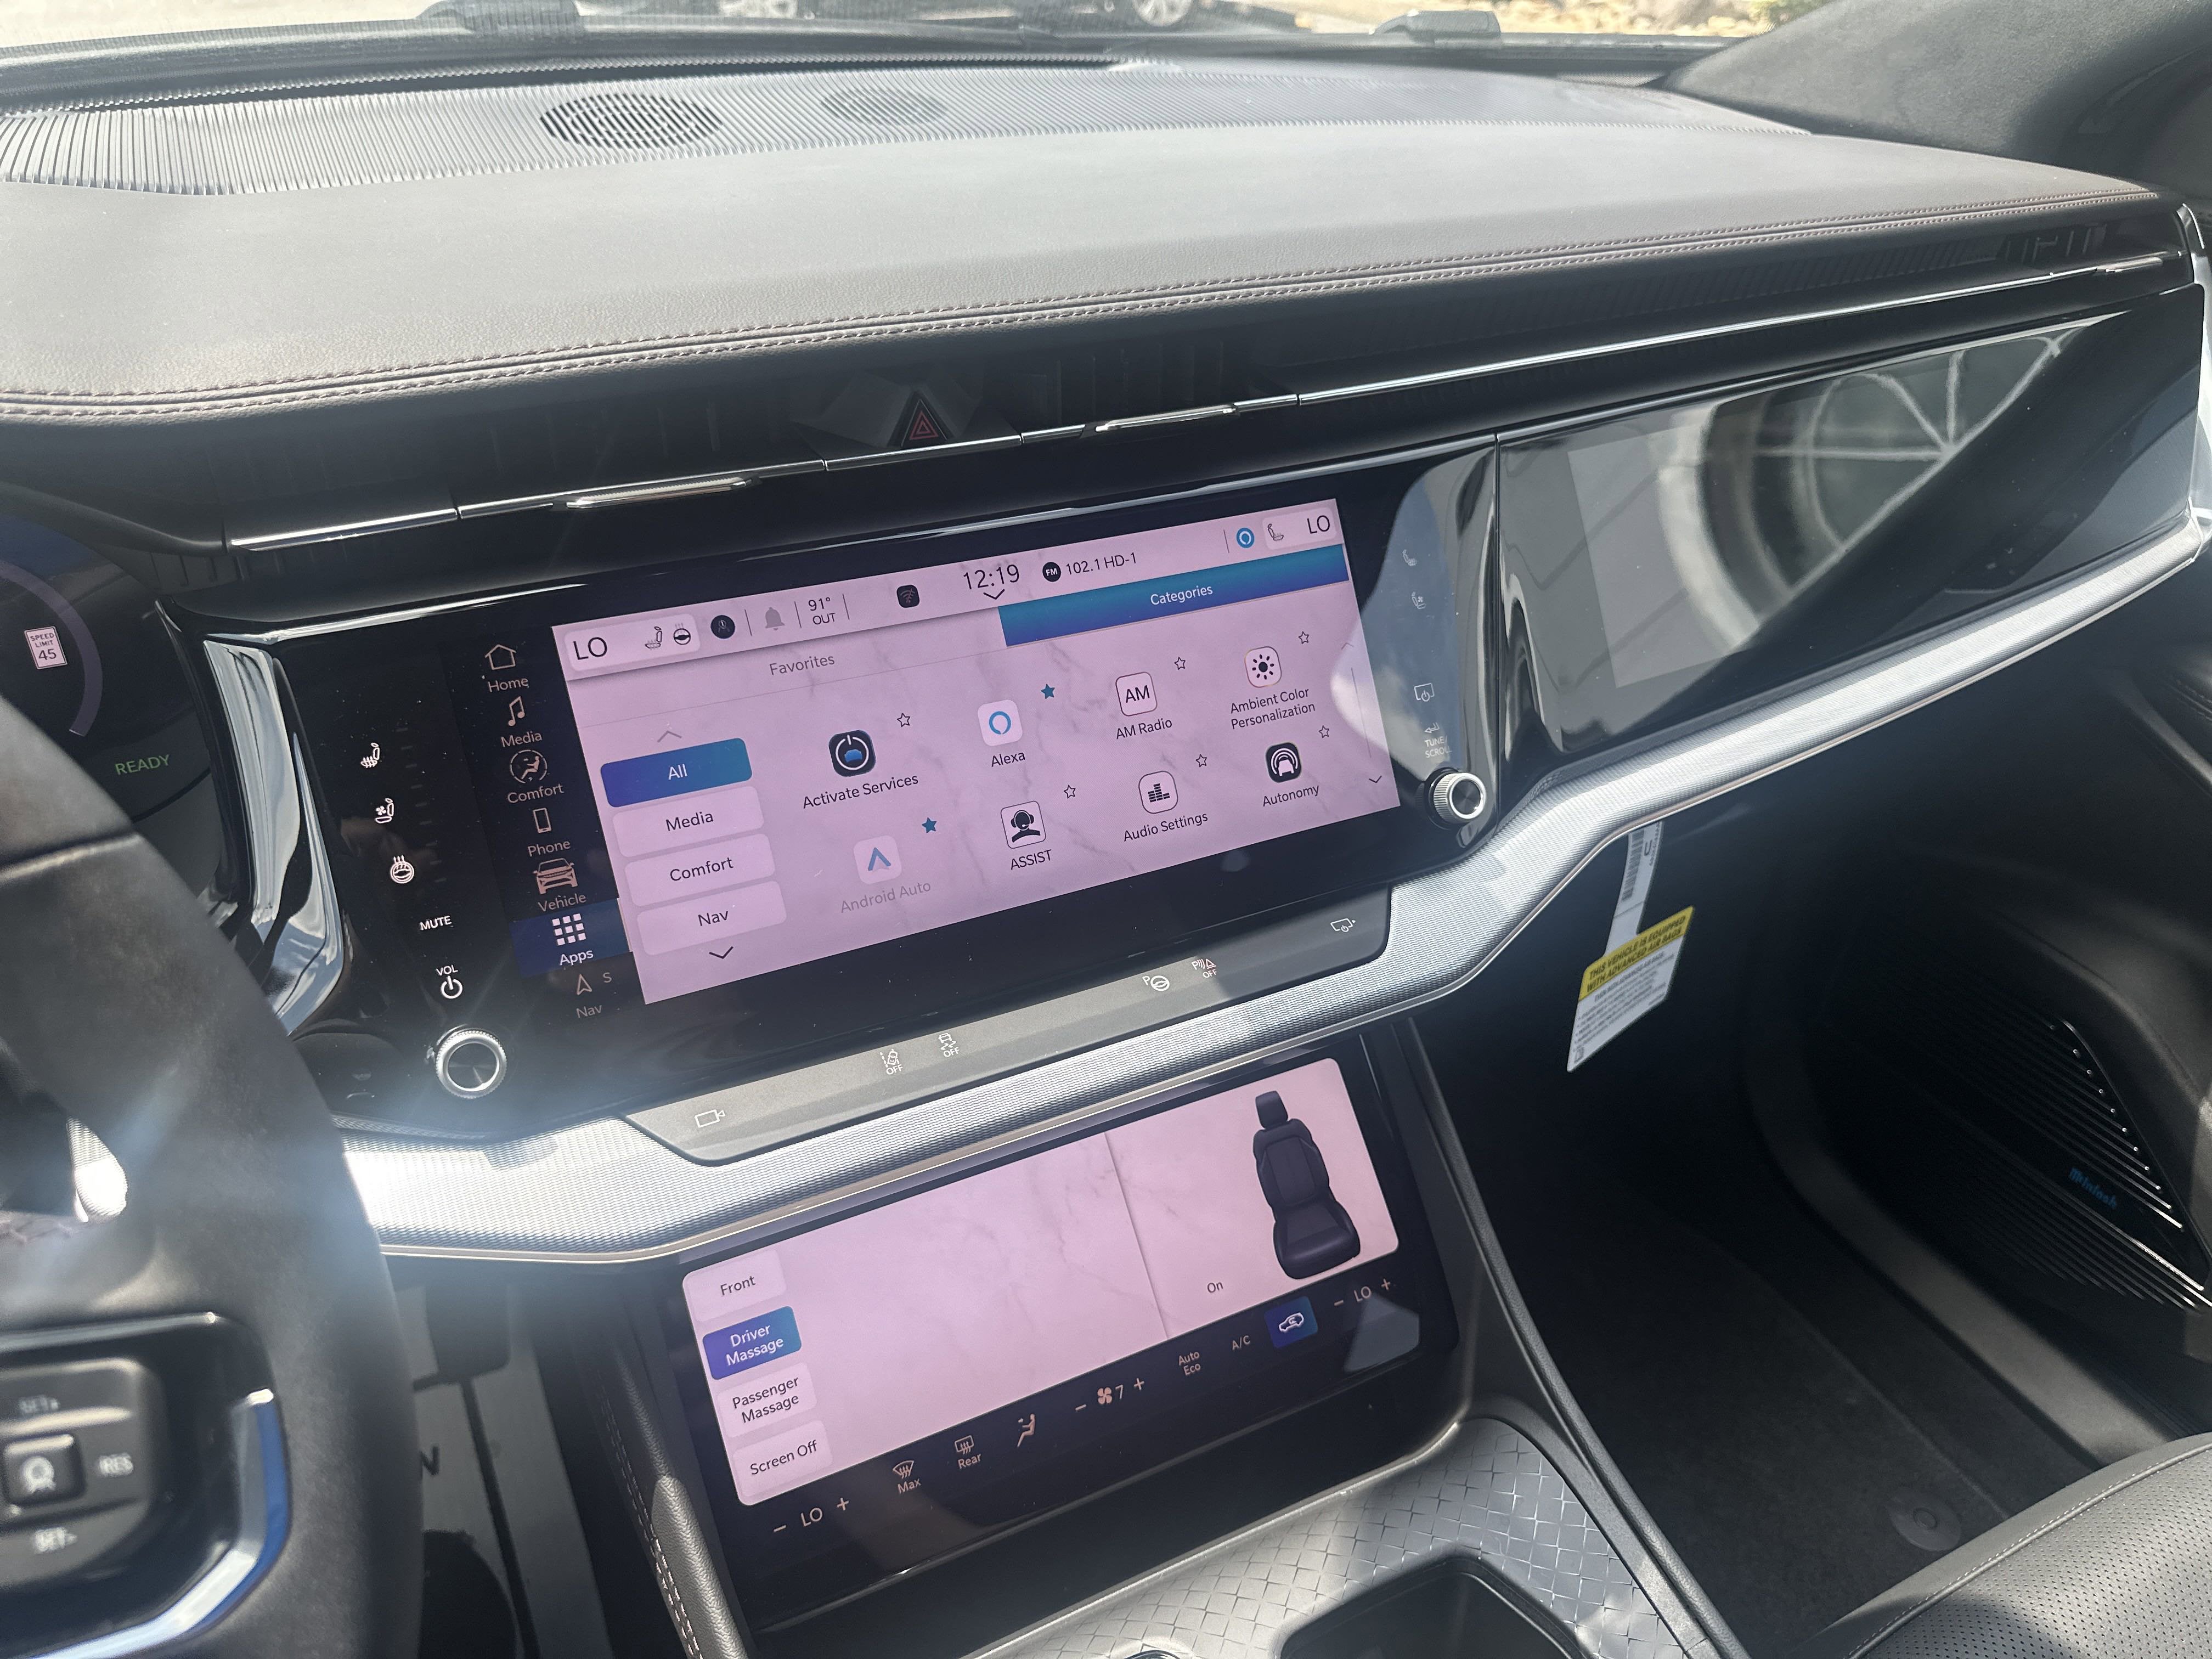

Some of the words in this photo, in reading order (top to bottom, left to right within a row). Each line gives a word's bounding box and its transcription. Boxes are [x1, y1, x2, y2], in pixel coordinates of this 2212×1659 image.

[1307, 515, 1330, 534] LO
[1046, 567, 1058, 576] FM
[1065, 557, 1100, 575] 102.1
[1104, 552, 1137, 569] HD-1
[963, 563, 1020, 590] 12:19
[1150, 584, 1213, 606] Categories
[808, 597, 831, 612] 91°
[812, 612, 836, 626] OUT
[30, 633, 54, 641] SPEED
[38, 648, 57, 661] 45
[573, 636, 608, 660] LO
[769, 654, 834, 675] Favorites
[488, 676, 529, 692] Home
[1125, 686, 1150, 703] AM
[1230, 693, 1278, 714] Ambient
[1280, 687, 1310, 704] Color
[1231, 701, 1315, 729] Personalization
[1116, 725, 1136, 739] AM
[1139, 718, 1172, 735] Radio
[500, 731, 543, 748] Media
[991, 751, 1025, 767] Alexa
[1425, 746, 1453, 758] SCROLL
[115, 754, 170, 775] READY
[668, 765, 687, 780] All
[507, 783, 565, 804] Comfort
[803, 787, 860, 809] Activate
[862, 774, 918, 795] Services
[1263, 785, 1319, 806] Autonomy
[665, 811, 714, 831] Media
[1124, 825, 1158, 843] Audio
[1161, 812, 1208, 832] Settings
[527, 839, 571, 856] Phone
[1011, 849, 1052, 870] ASSIST
[670, 856, 734, 882] Comfort
[538, 893, 586, 912] Vehicle
[841, 888, 896, 913] Android
[900, 882, 931, 898] Auto
[420, 916, 452, 930] MUTE
[698, 910, 729, 927] Nav
[559, 949, 594, 966] Apps
[1590, 962, 1606, 980] THIS
[1607, 941, 1638, 967] VEHICLE
[436, 964, 458, 976] VOL
[603, 972, 612, 983] S
[1202, 969, 1217, 978] OFF
[1587, 973, 1606, 992] WITH
[1609, 946, 1647, 975] ADVANCED
[576, 1004, 603, 1018] Nav
[943, 1047, 960, 1058] OFF
[886, 1064, 903, 1075] OFF
[720, 1276, 755, 1296] Front
[1207, 1281, 1223, 1294] On
[1354, 1286, 1371, 1304] LO
[730, 1323, 771, 1347] Driver
[1231, 1335, 1251, 1351] A/C
[726, 1336, 784, 1366] Massage
[1178, 1351, 1200, 1365] Auto
[1183, 1362, 1201, 1376] Eco
[732, 1376, 799, 1409] Passenger
[1115, 1385, 1124, 1400] 7
[741, 1394, 799, 1423] Massage
[750, 1452, 794, 1475] Screen
[797, 1440, 817, 1457] Off
[958, 1453, 981, 1469] Rear
[898, 1477, 921, 1494] Max
[800, 1507, 823, 1527] LO
